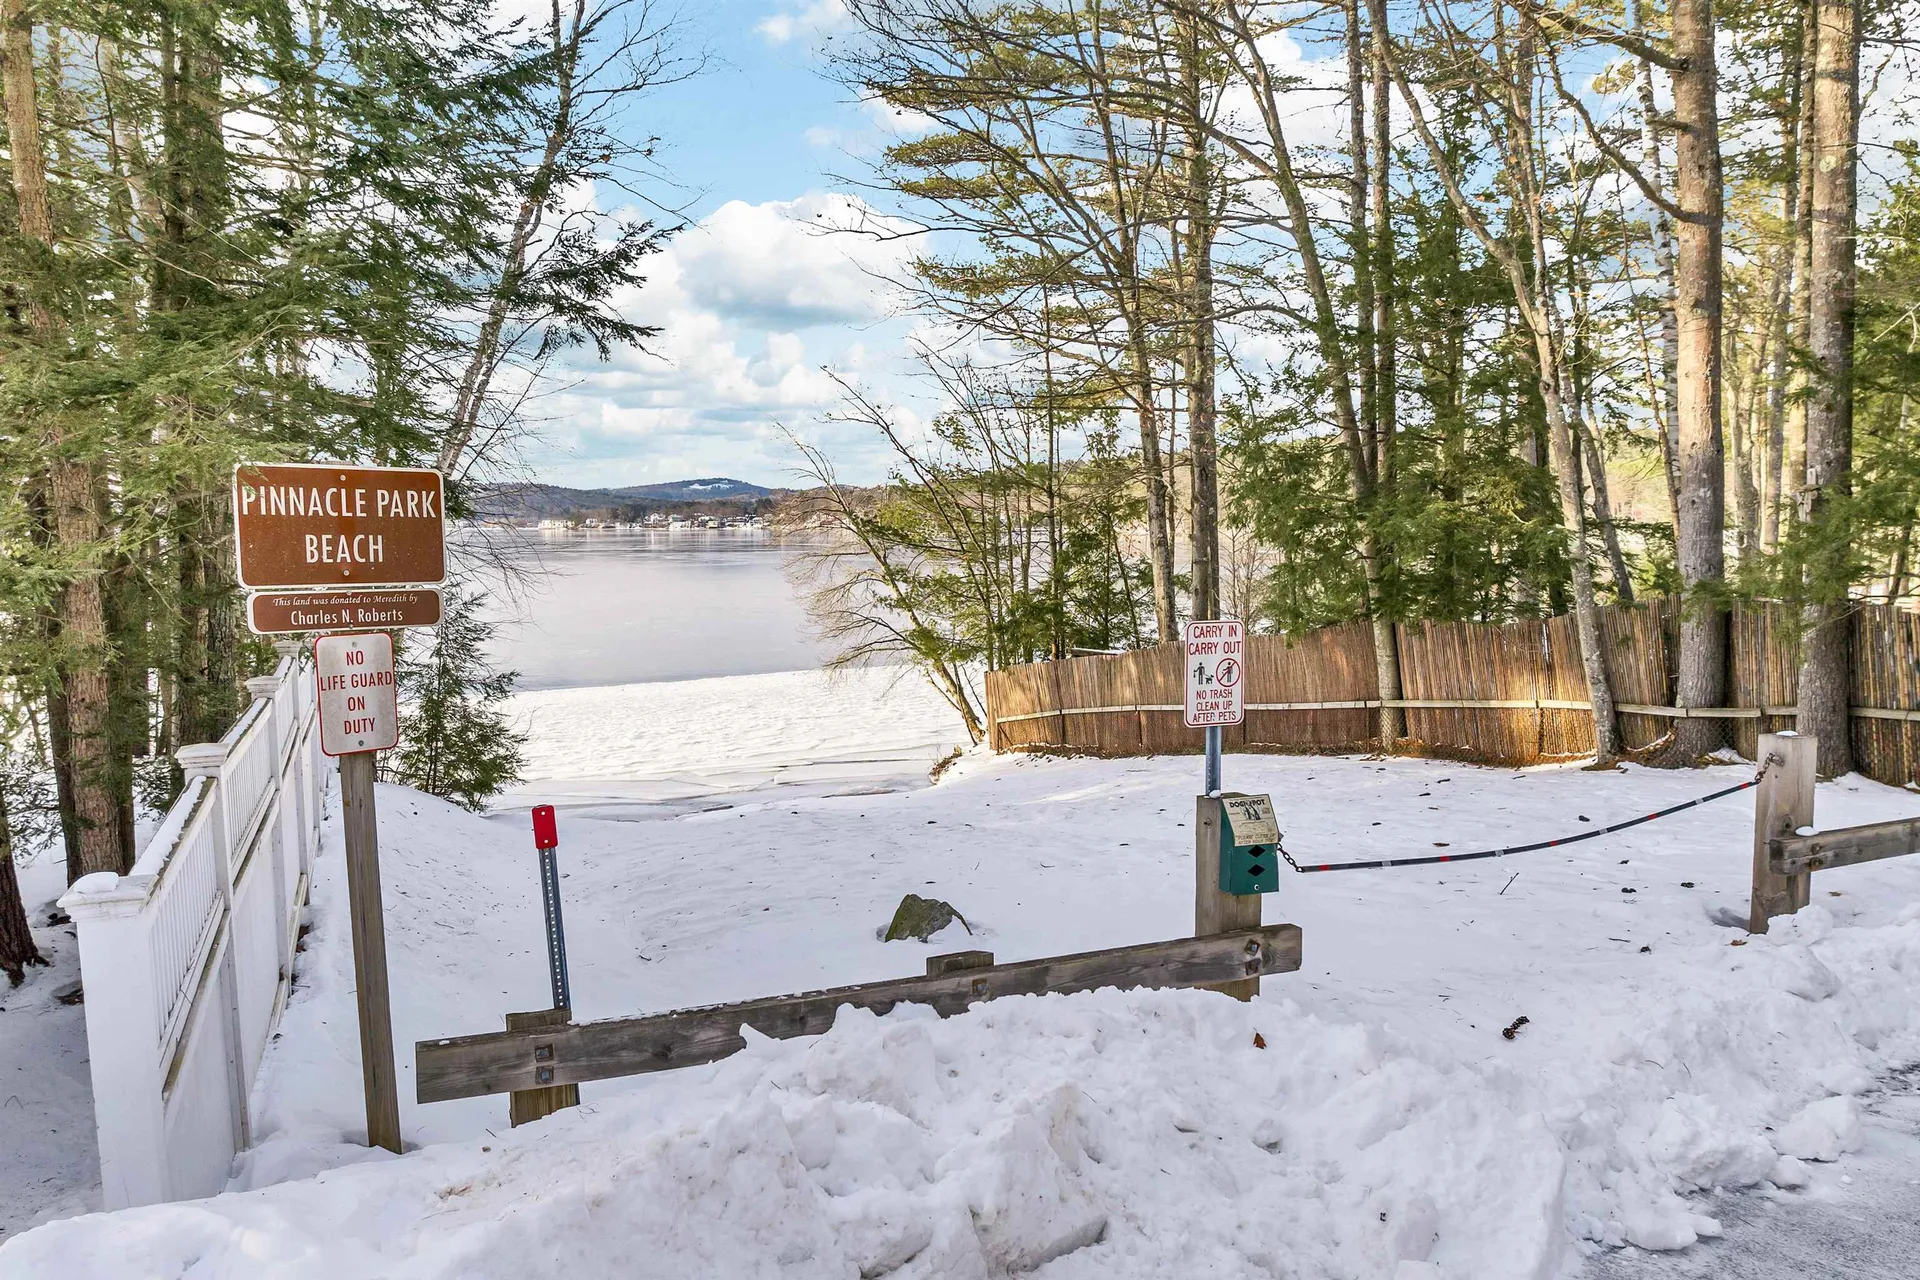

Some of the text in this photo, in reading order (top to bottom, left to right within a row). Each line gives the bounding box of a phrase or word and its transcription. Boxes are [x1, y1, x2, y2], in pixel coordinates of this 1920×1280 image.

[241, 485, 437, 518] PINNACLE PARK
[305, 534, 384, 563] BEACH
[273, 597, 291, 607] This
[292, 596, 310, 606] land
[330, 595, 361, 604] donated
[363, 596, 371, 604] to
[372, 594, 407, 604] Meredith
[409, 593, 418, 605] by
[291, 607, 403, 625] Charles N. Roberts
[1193, 625, 1237, 639] CARRY IN
[1188, 641, 1241, 655] CARRY OUT
[346, 650, 364, 666] NO
[320, 671, 393, 691] LIFE GUARD
[1196, 689, 1233, 700] NO TRASH
[347, 696, 365, 711] ON
[1196, 700, 1233, 712] CLEAN UP
[1219, 711, 1237, 721] PETS
[344, 717, 375, 735] DUTY
